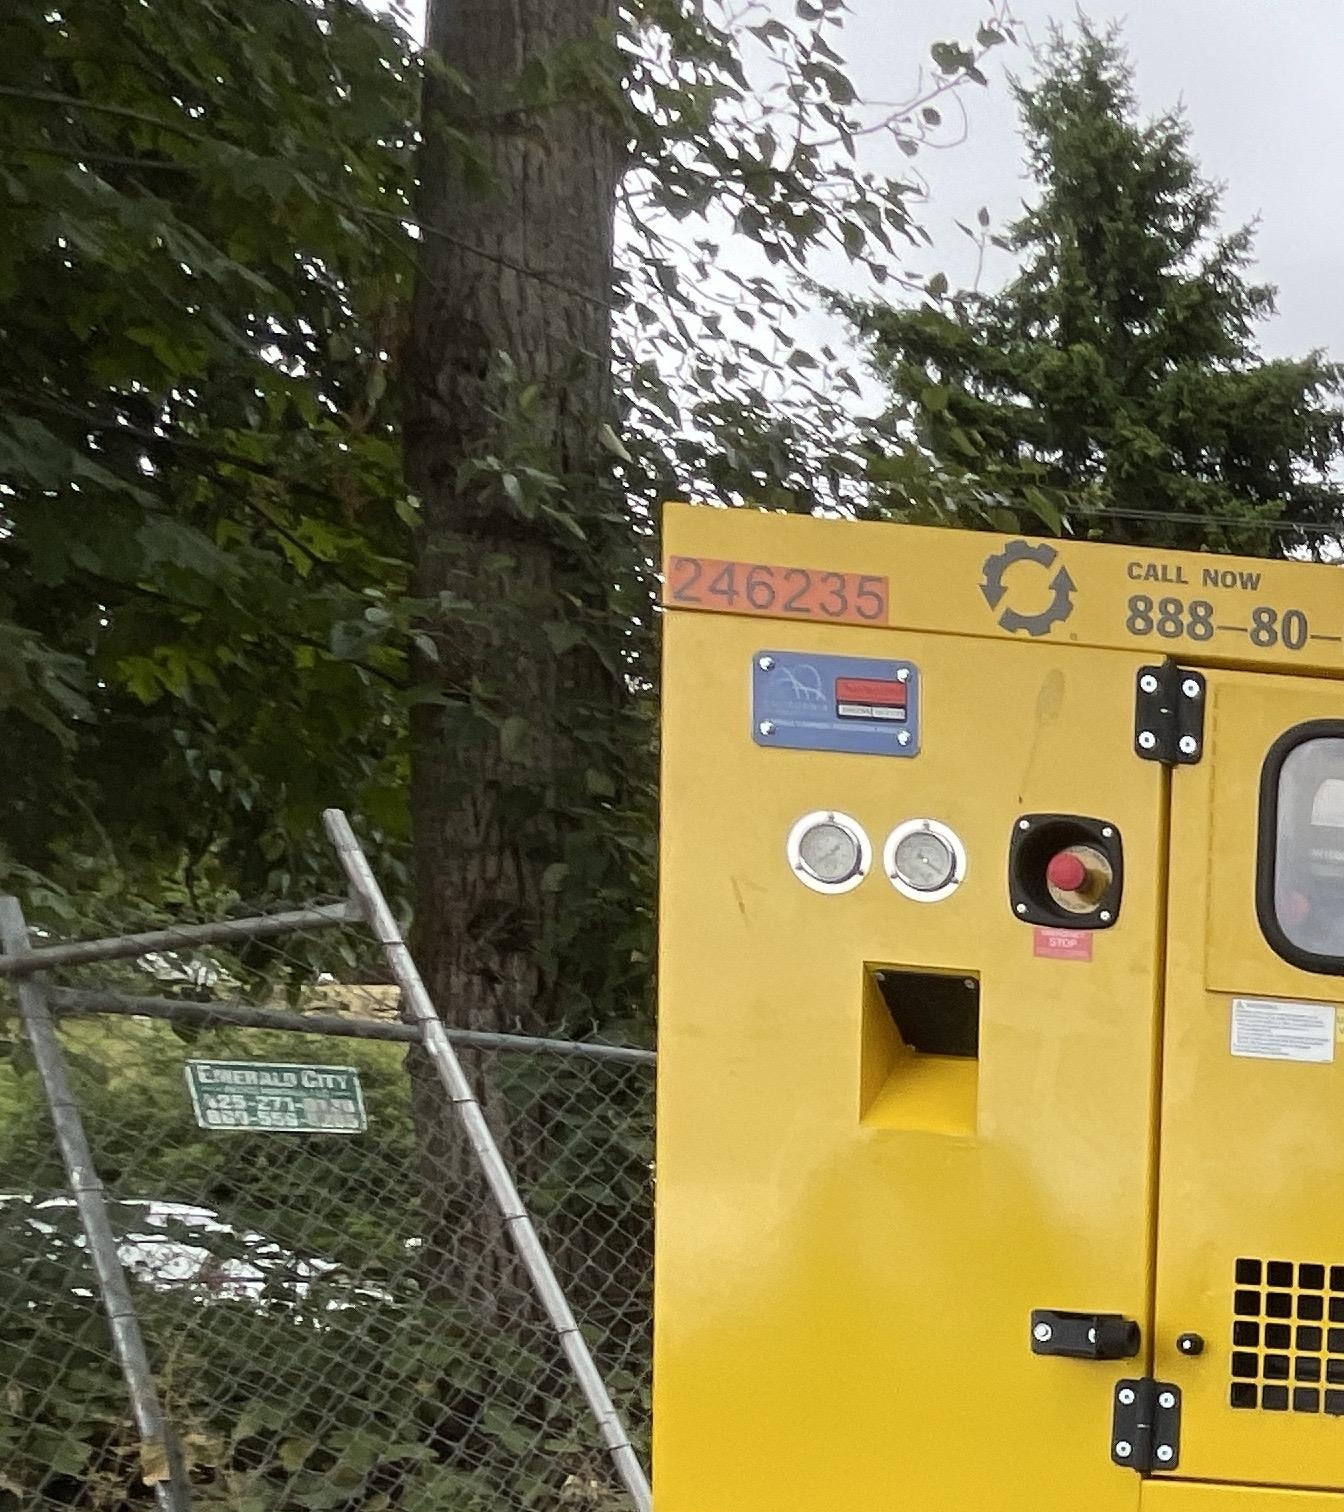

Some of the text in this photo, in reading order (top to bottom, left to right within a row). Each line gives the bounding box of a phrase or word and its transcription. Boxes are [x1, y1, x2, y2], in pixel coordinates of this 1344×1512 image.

[672, 556, 885, 620] 246235
[1126, 562, 1262, 591] CALL NOW
[1048, 937, 1078, 948] STOP
[197, 1064, 348, 1090] EMERALD CITY
